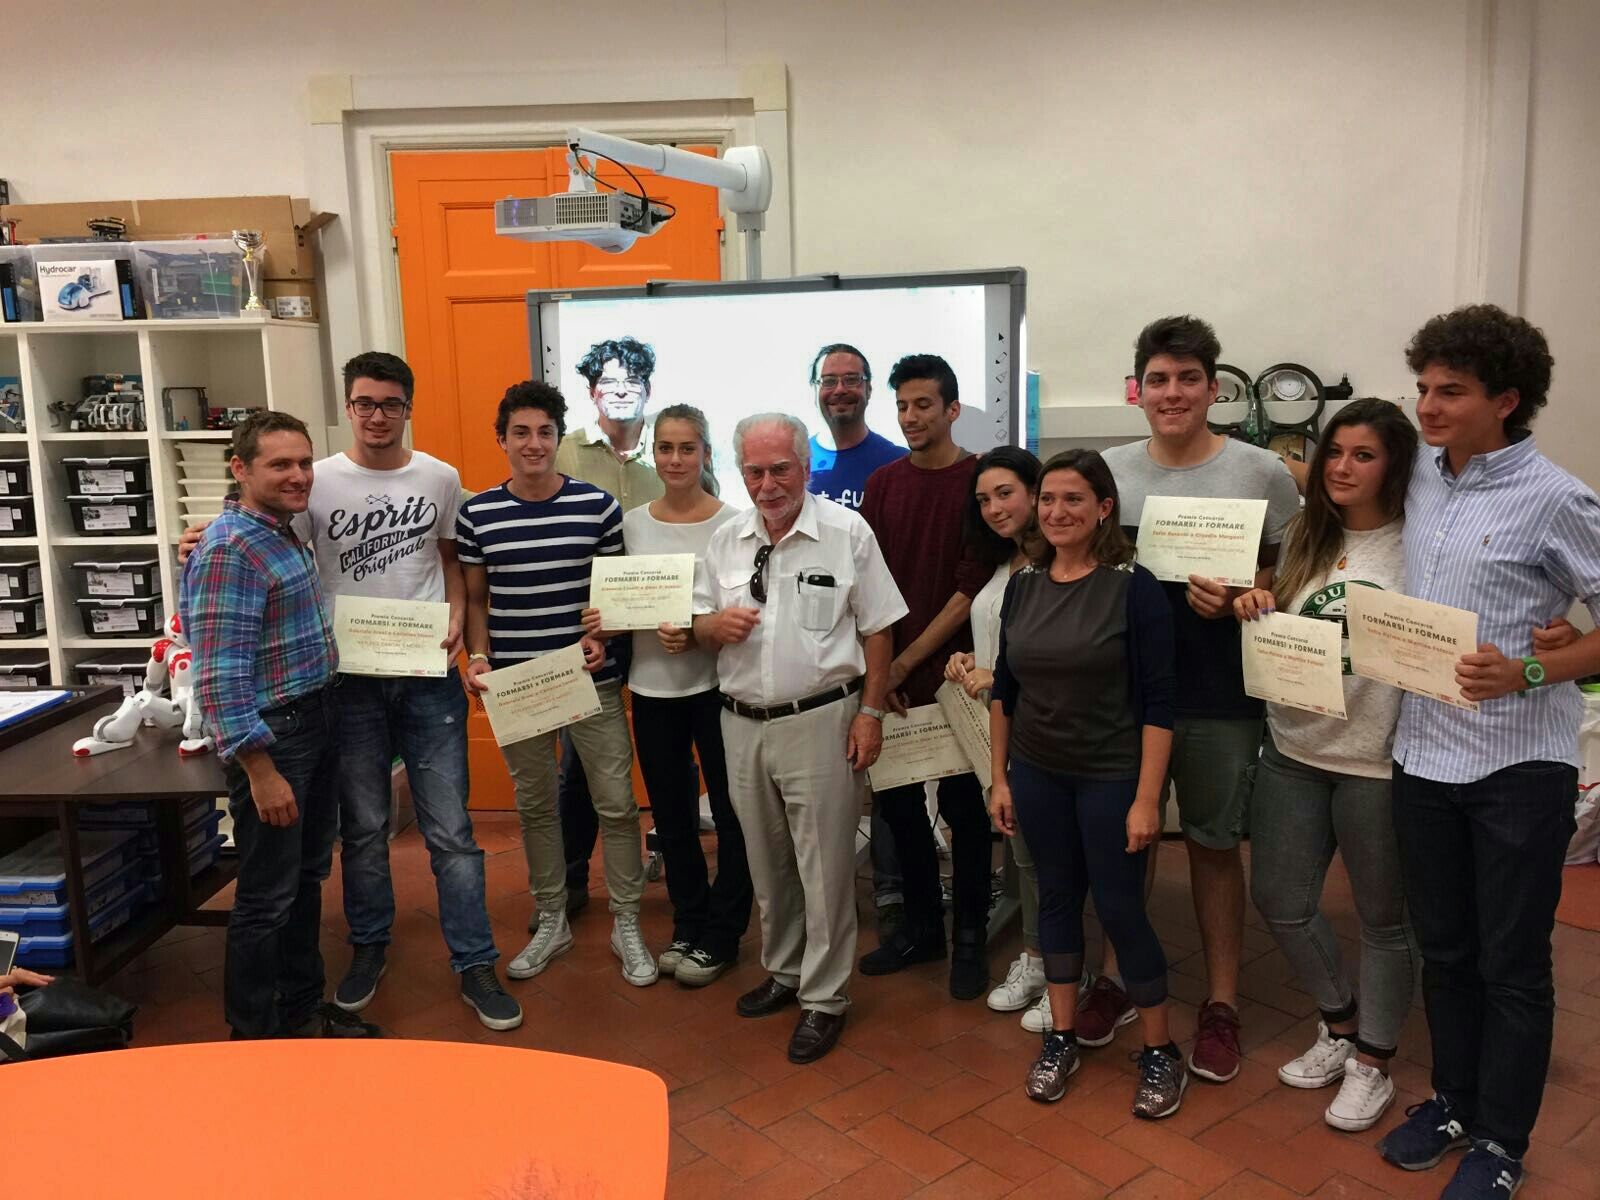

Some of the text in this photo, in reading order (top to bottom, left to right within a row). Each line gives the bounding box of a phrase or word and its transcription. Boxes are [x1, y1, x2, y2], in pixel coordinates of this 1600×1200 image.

[40, 265, 76, 274] Hydrocar
[328, 497, 430, 541] Esprit
[1155, 520, 1196, 528] FORMARSI
[1205, 522, 1245, 530] FORMARE
[341, 530, 409, 571] CALIFORNIA
[354, 536, 425, 582] Originals
[647, 574, 680, 582] FORMARE
[350, 618, 390, 626] FORMARSI
[398, 621, 433, 629] FORMARE
[1384, 612, 1404, 622] Premio
[1362, 614, 1405, 632] FORMARSI
[1415, 628, 1457, 645] FORMARE
[1254, 635, 1287, 649] FORMARSI
[1294, 643, 1327, 656] FORMARE
[496, 682, 534, 699] FORMARSI
[541, 668, 574, 684] FORMARE
[882, 731, 912, 741] RMARSI
